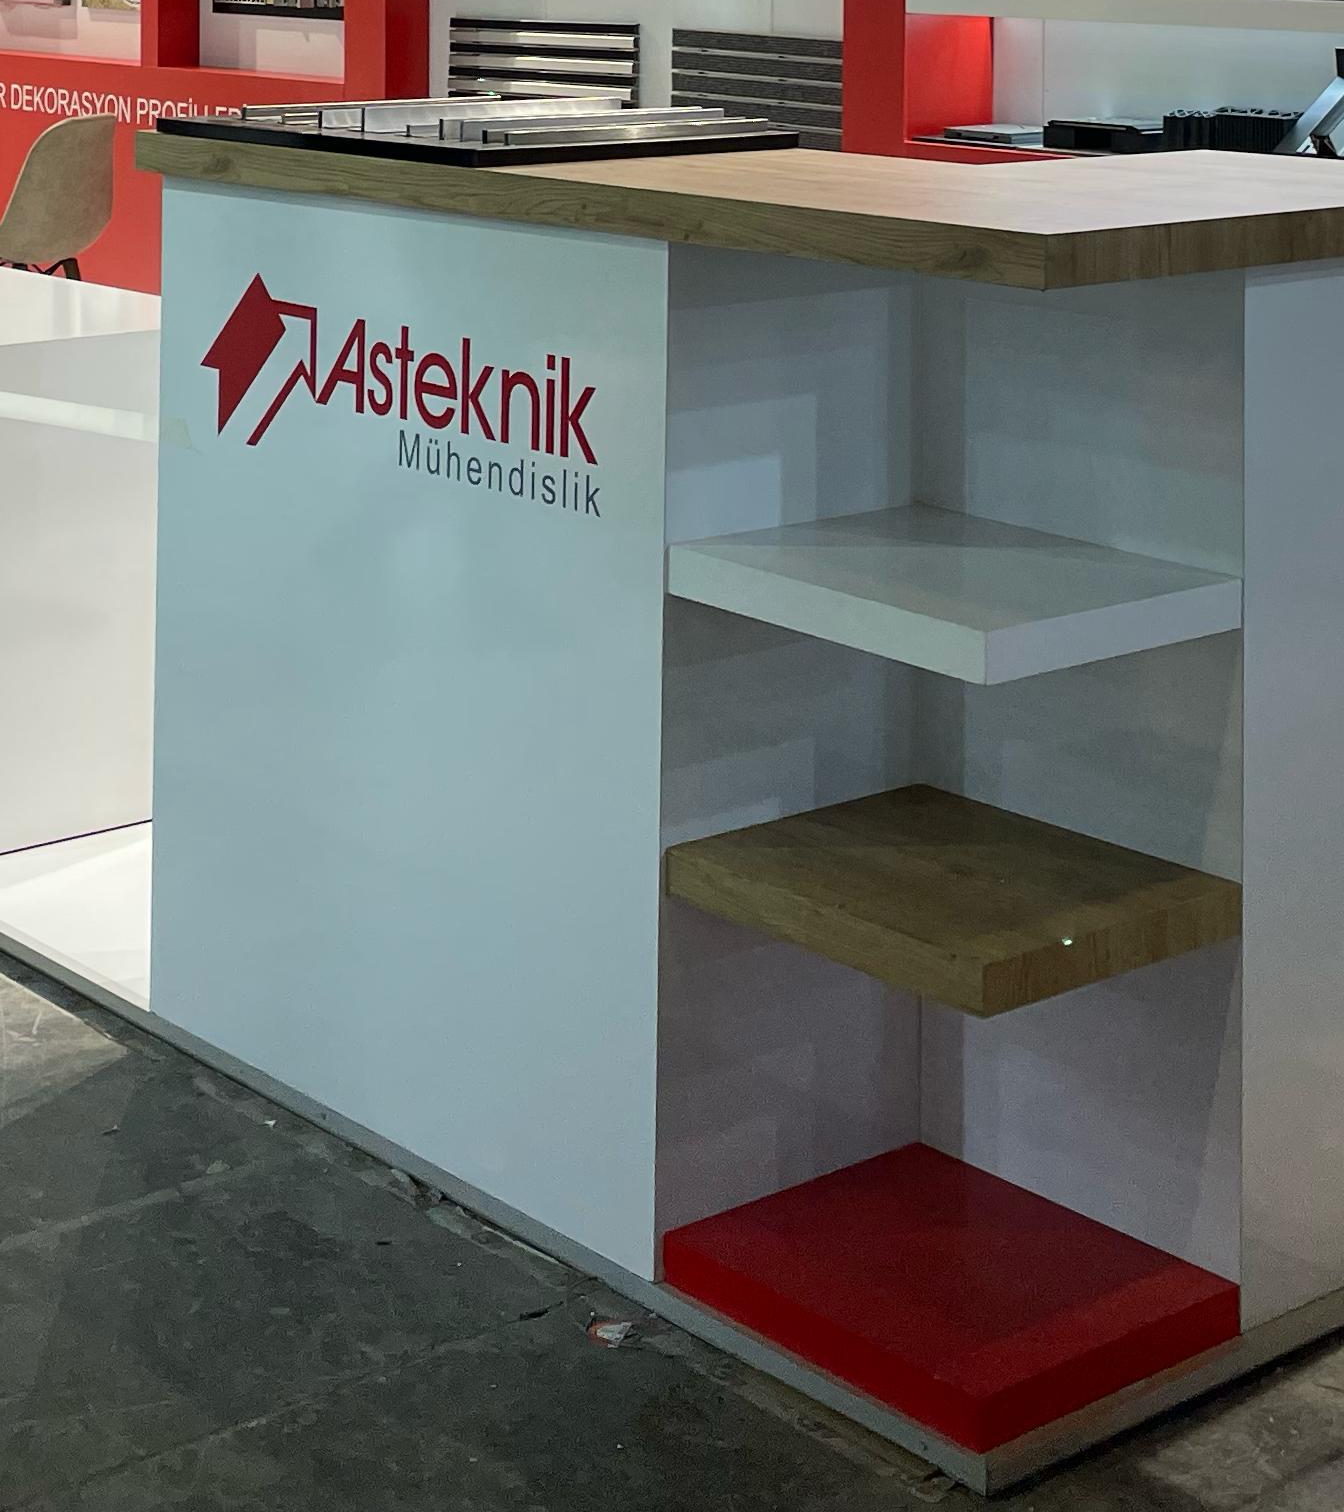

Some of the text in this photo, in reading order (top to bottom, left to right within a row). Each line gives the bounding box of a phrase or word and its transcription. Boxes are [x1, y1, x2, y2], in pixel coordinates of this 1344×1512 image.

[10, 83, 132, 125] DEKORASYON
[136, 97, 248, 126] PROFİ
[315, 318, 600, 466] Asteknik
[397, 428, 602, 518] Mühendislik
